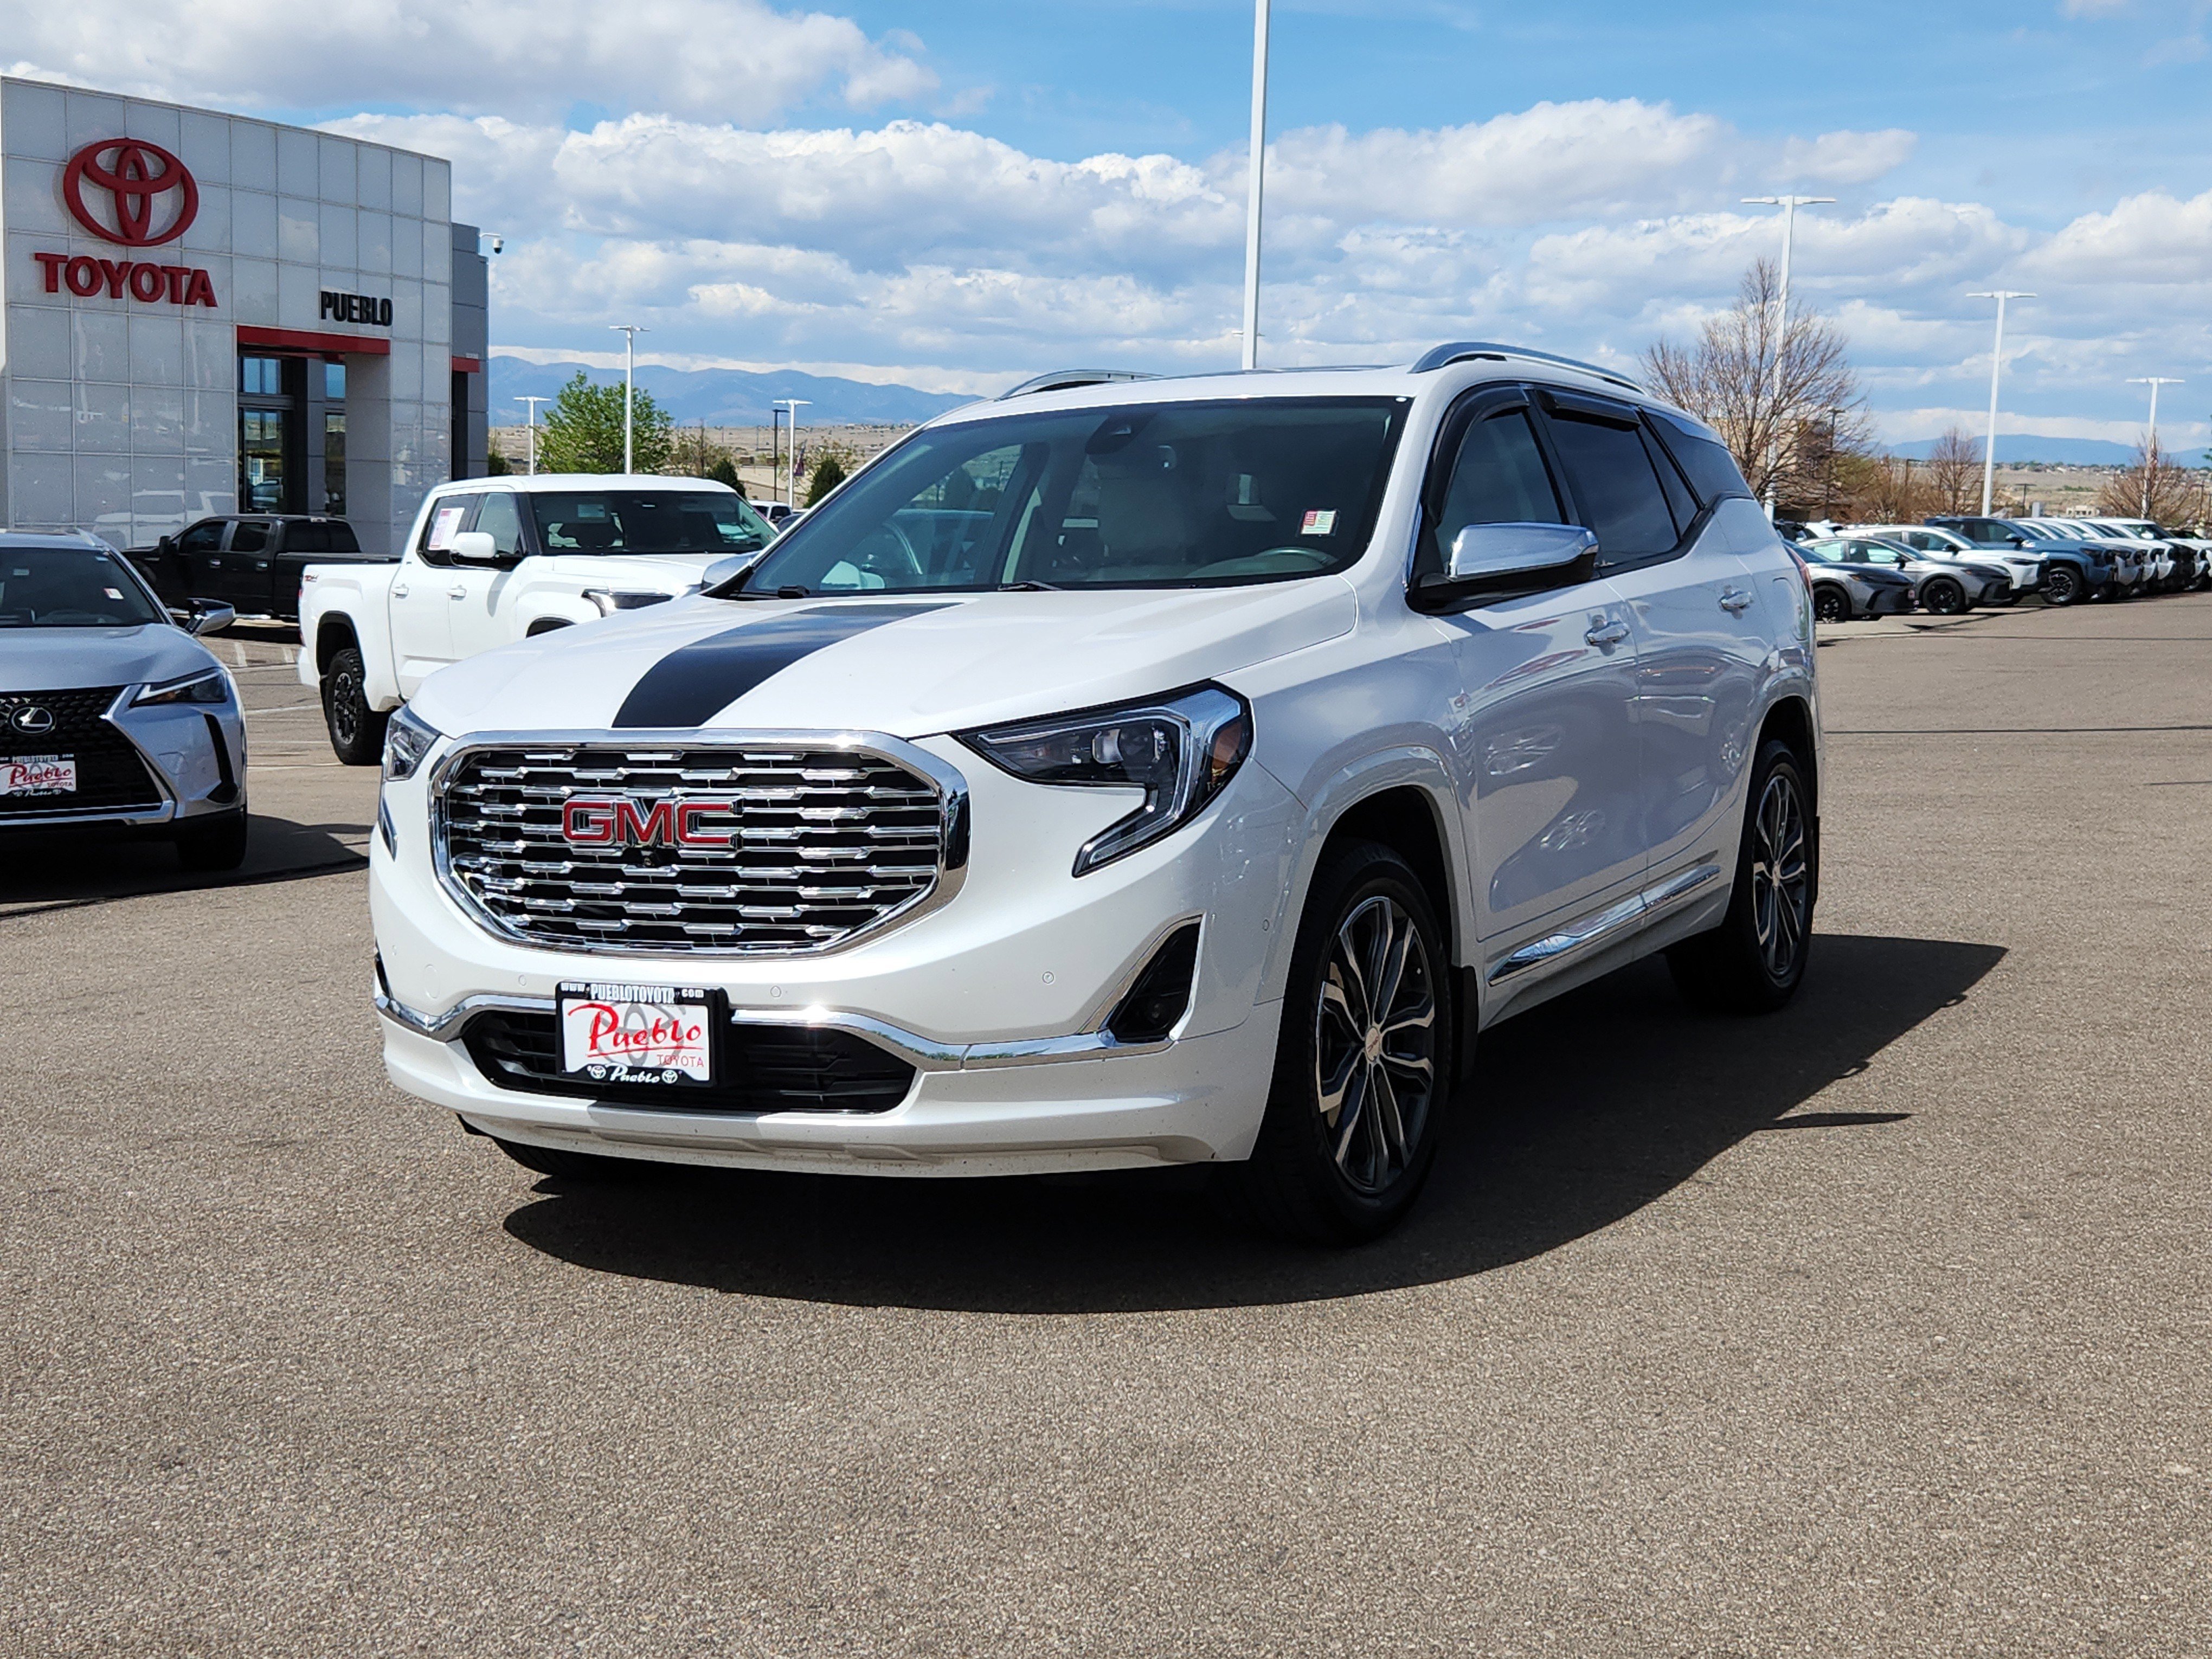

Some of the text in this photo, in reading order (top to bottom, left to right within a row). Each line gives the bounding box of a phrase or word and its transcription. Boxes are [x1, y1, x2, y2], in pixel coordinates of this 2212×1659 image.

[34, 252, 218, 308] TOYOTA
[320, 291, 393, 326] PUEBLO
[0, 764, 72, 785] Pueblo
[562, 800, 733, 845] GMC
[567, 1003, 702, 1051] Pueblo
[605, 1063, 660, 1083] Pueblo
[657, 1053, 704, 1068] TOYOTA
